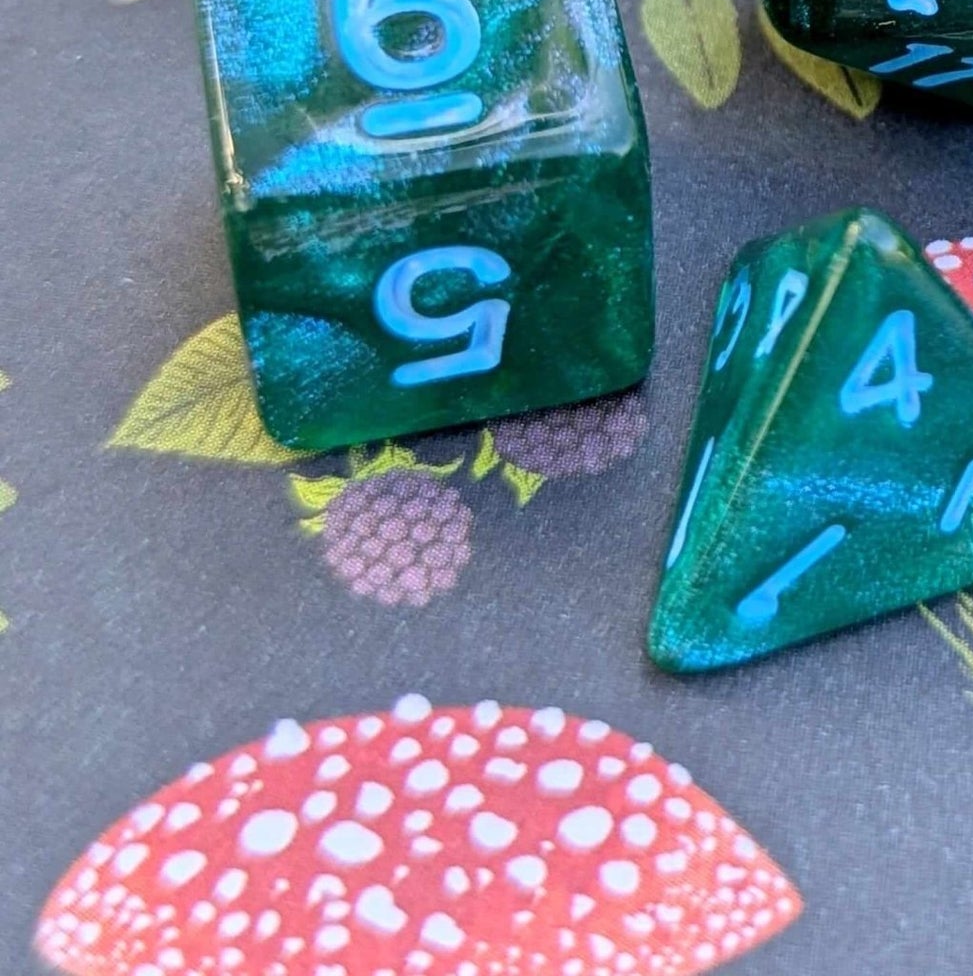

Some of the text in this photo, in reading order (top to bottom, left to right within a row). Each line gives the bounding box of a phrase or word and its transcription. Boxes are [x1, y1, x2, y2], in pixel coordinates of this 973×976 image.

[375, 245, 511, 391] 5
[839, 309, 933, 428] 4
[735, 524, 845, 629] 1
